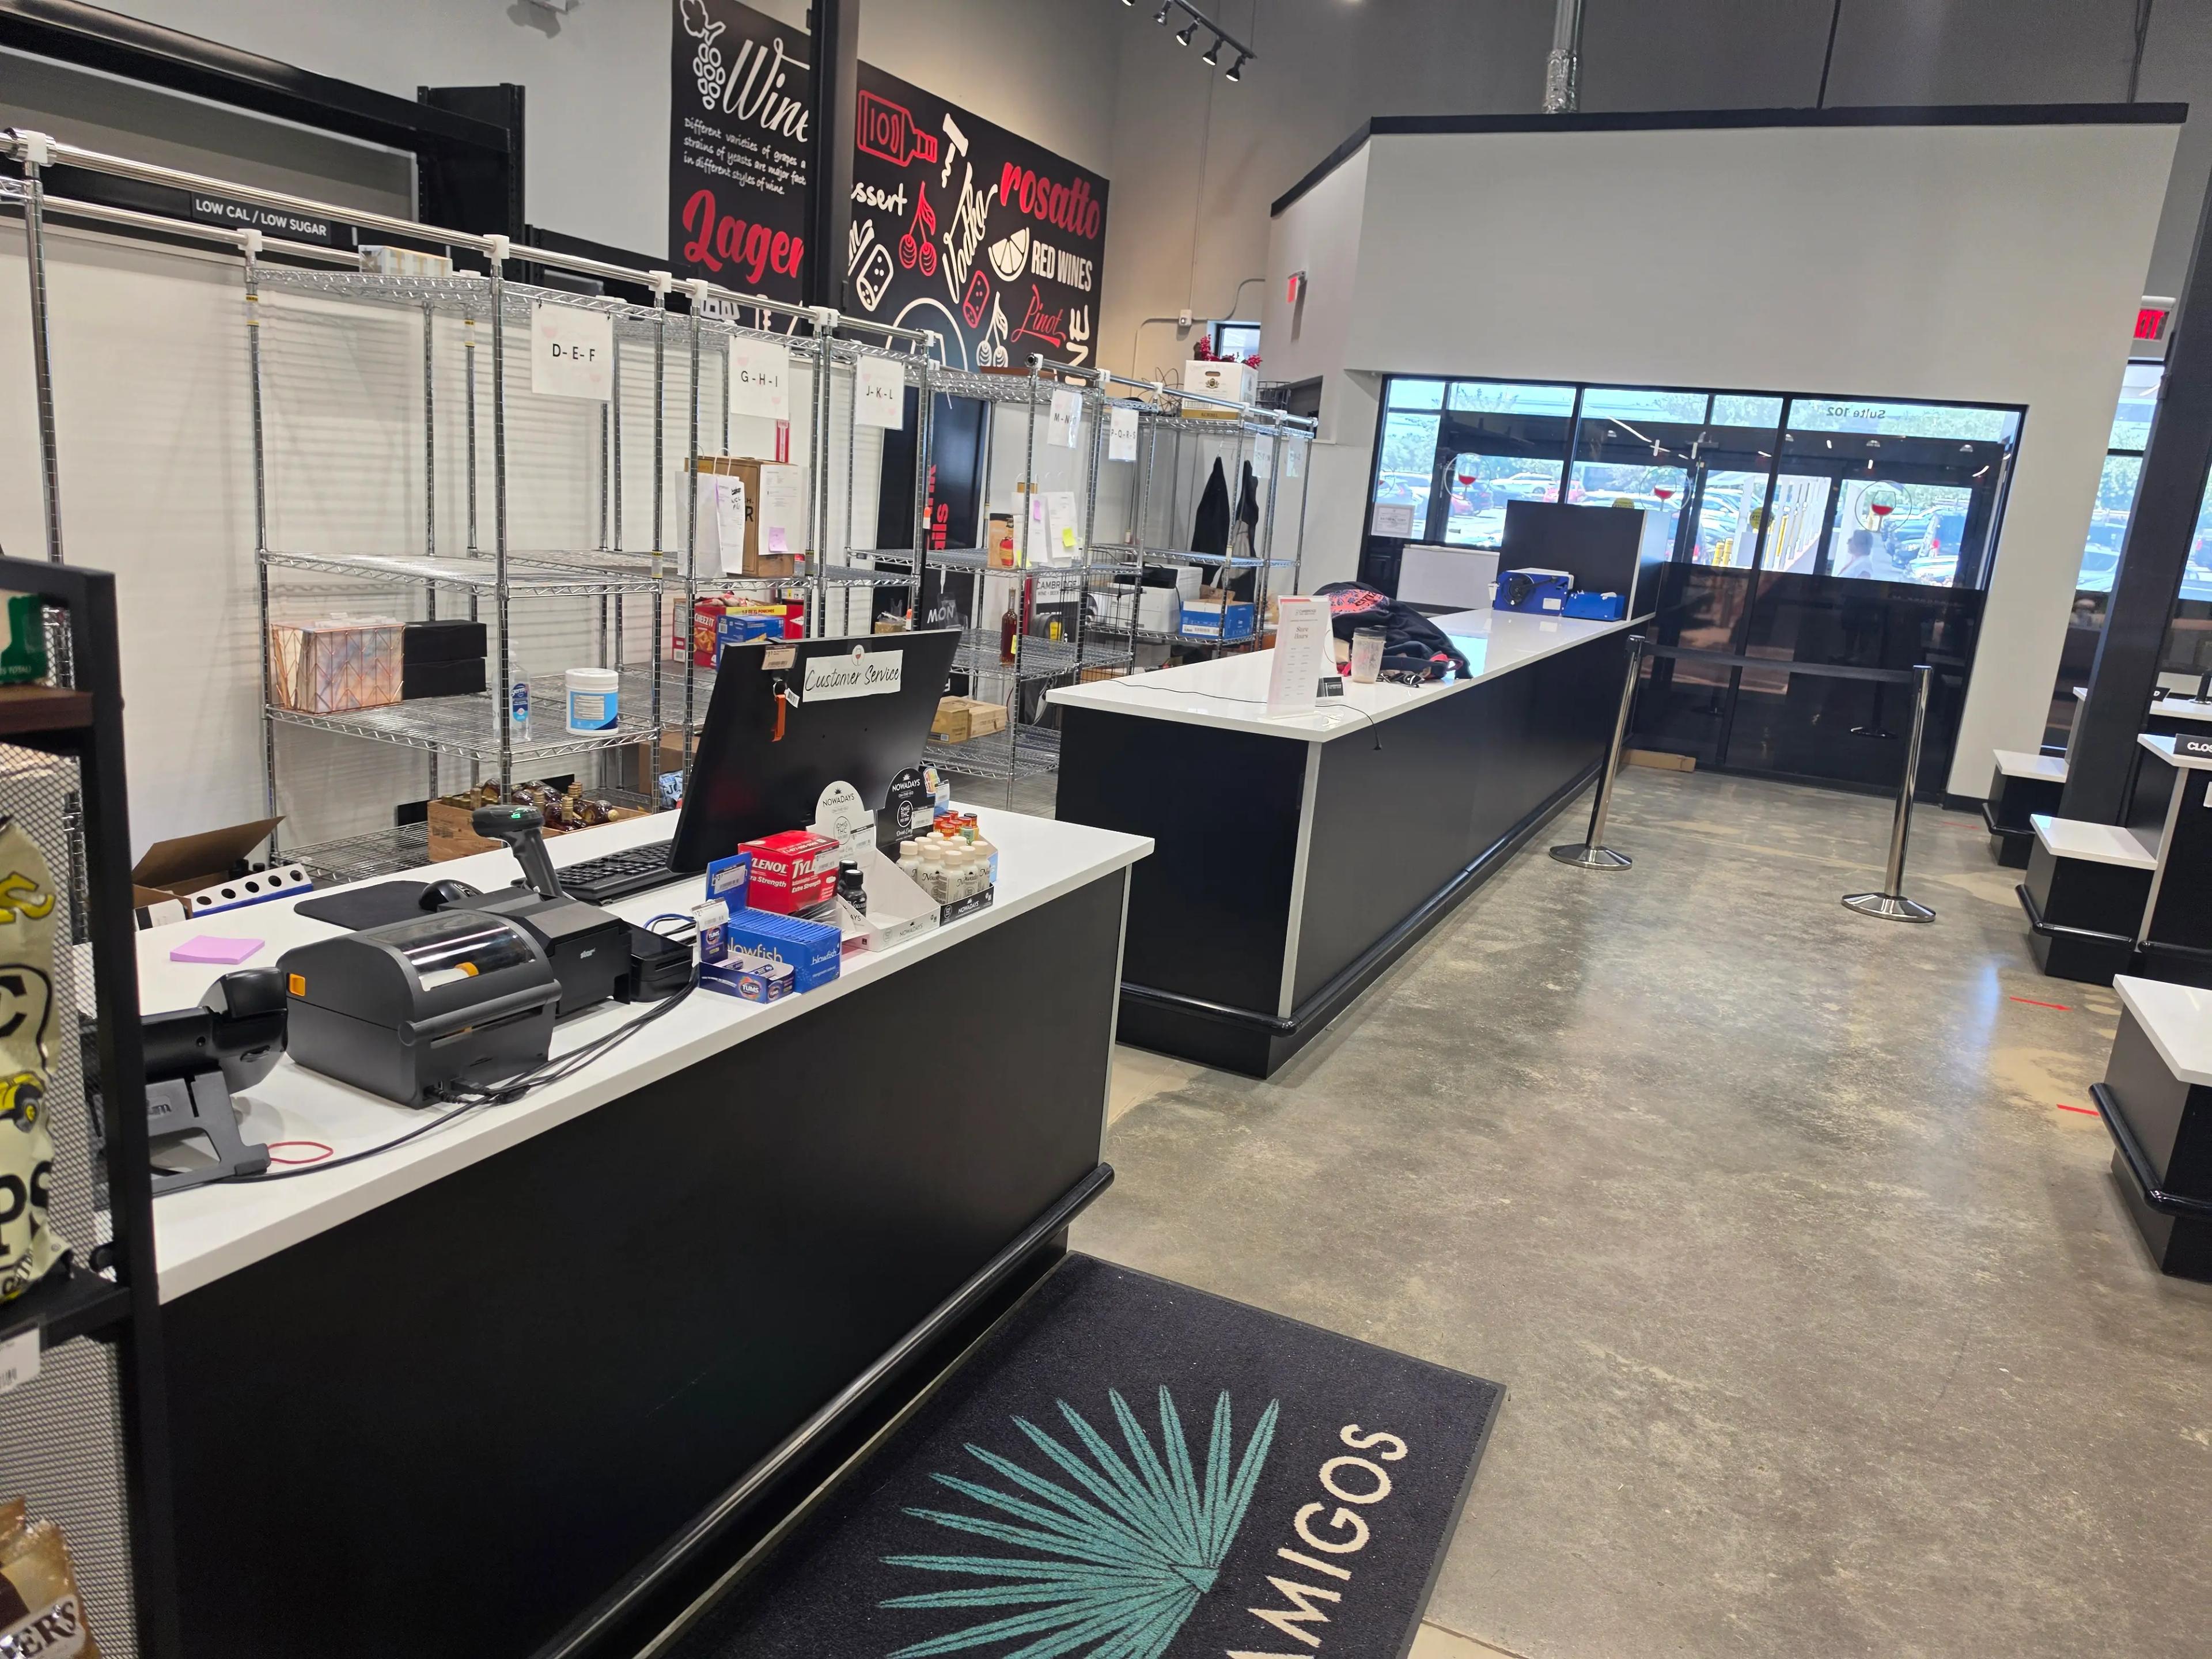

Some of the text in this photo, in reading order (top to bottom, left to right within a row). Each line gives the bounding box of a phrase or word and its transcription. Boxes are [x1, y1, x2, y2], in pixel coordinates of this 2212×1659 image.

[684, 117, 722, 139] Different
[726, 134, 758, 151] varieties
[762, 145, 771, 159] of
[774, 151, 798, 166] grapes
[683, 137, 714, 154] strains
[716, 146, 726, 161] of
[728, 151, 752, 167] yeasts
[754, 161, 767, 172] are
[768, 165, 790, 182] major
[684, 150, 695, 165] in
[695, 156, 731, 177] different
[732, 170, 756, 187] styles
[756, 176, 766, 191] of
[851, 182, 908, 216] ssert
[1000, 162, 1100, 240] rosatto
[195, 199, 327, 236] LOW CAL / LOW SUGAR
[683, 190, 804, 284] Lager
[942, 162, 998, 304] Vodka
[1031, 240, 1093, 292] RED WINES
[1010, 283, 1067, 349] Pinot
[804, 665, 900, 692] Customer Service
[510, 687, 525, 697] germ
[892, 779, 921, 793] NOWADAYS
[822, 793, 855, 807] NOWADAYS
[751, 857, 788, 874] YLENOL
[757, 876, 787, 888] Strength
[791, 885, 804, 893] Extra
[803, 879, 821, 890] Strength
[957, 900, 979, 914] NOWADAYS
[708, 930, 720, 939] TUMS
[899, 923, 923, 937] NOWADAYS
[727, 937, 783, 963] lowfish
[811, 948, 838, 965] blowfish
[743, 983, 760, 994] TUMS
[1225, 1423, 1410, 1659] MIGOS
